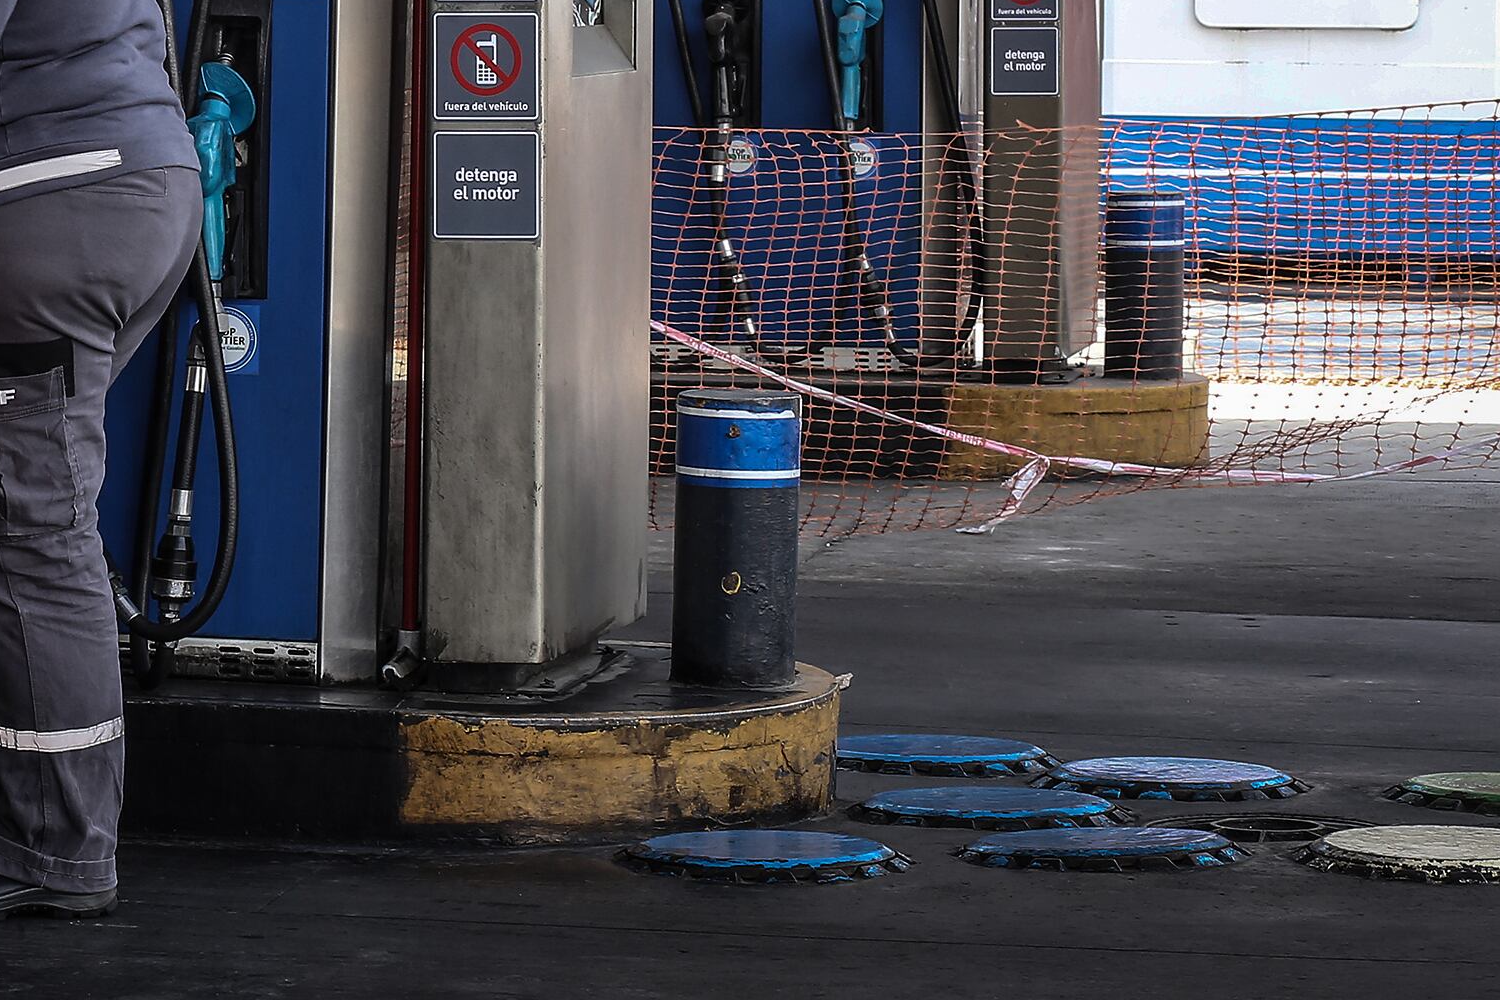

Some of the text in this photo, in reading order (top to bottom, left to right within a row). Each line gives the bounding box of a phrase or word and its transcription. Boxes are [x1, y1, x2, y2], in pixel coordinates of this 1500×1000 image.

[1005, 50, 1045, 61] detenga
[1004, 61, 1046, 70] el motor
[444, 101, 529, 111] fuera del vehículo
[455, 167, 517, 185] detenga
[453, 185, 520, 200] el motor
[223, 336, 245, 346] TIER
